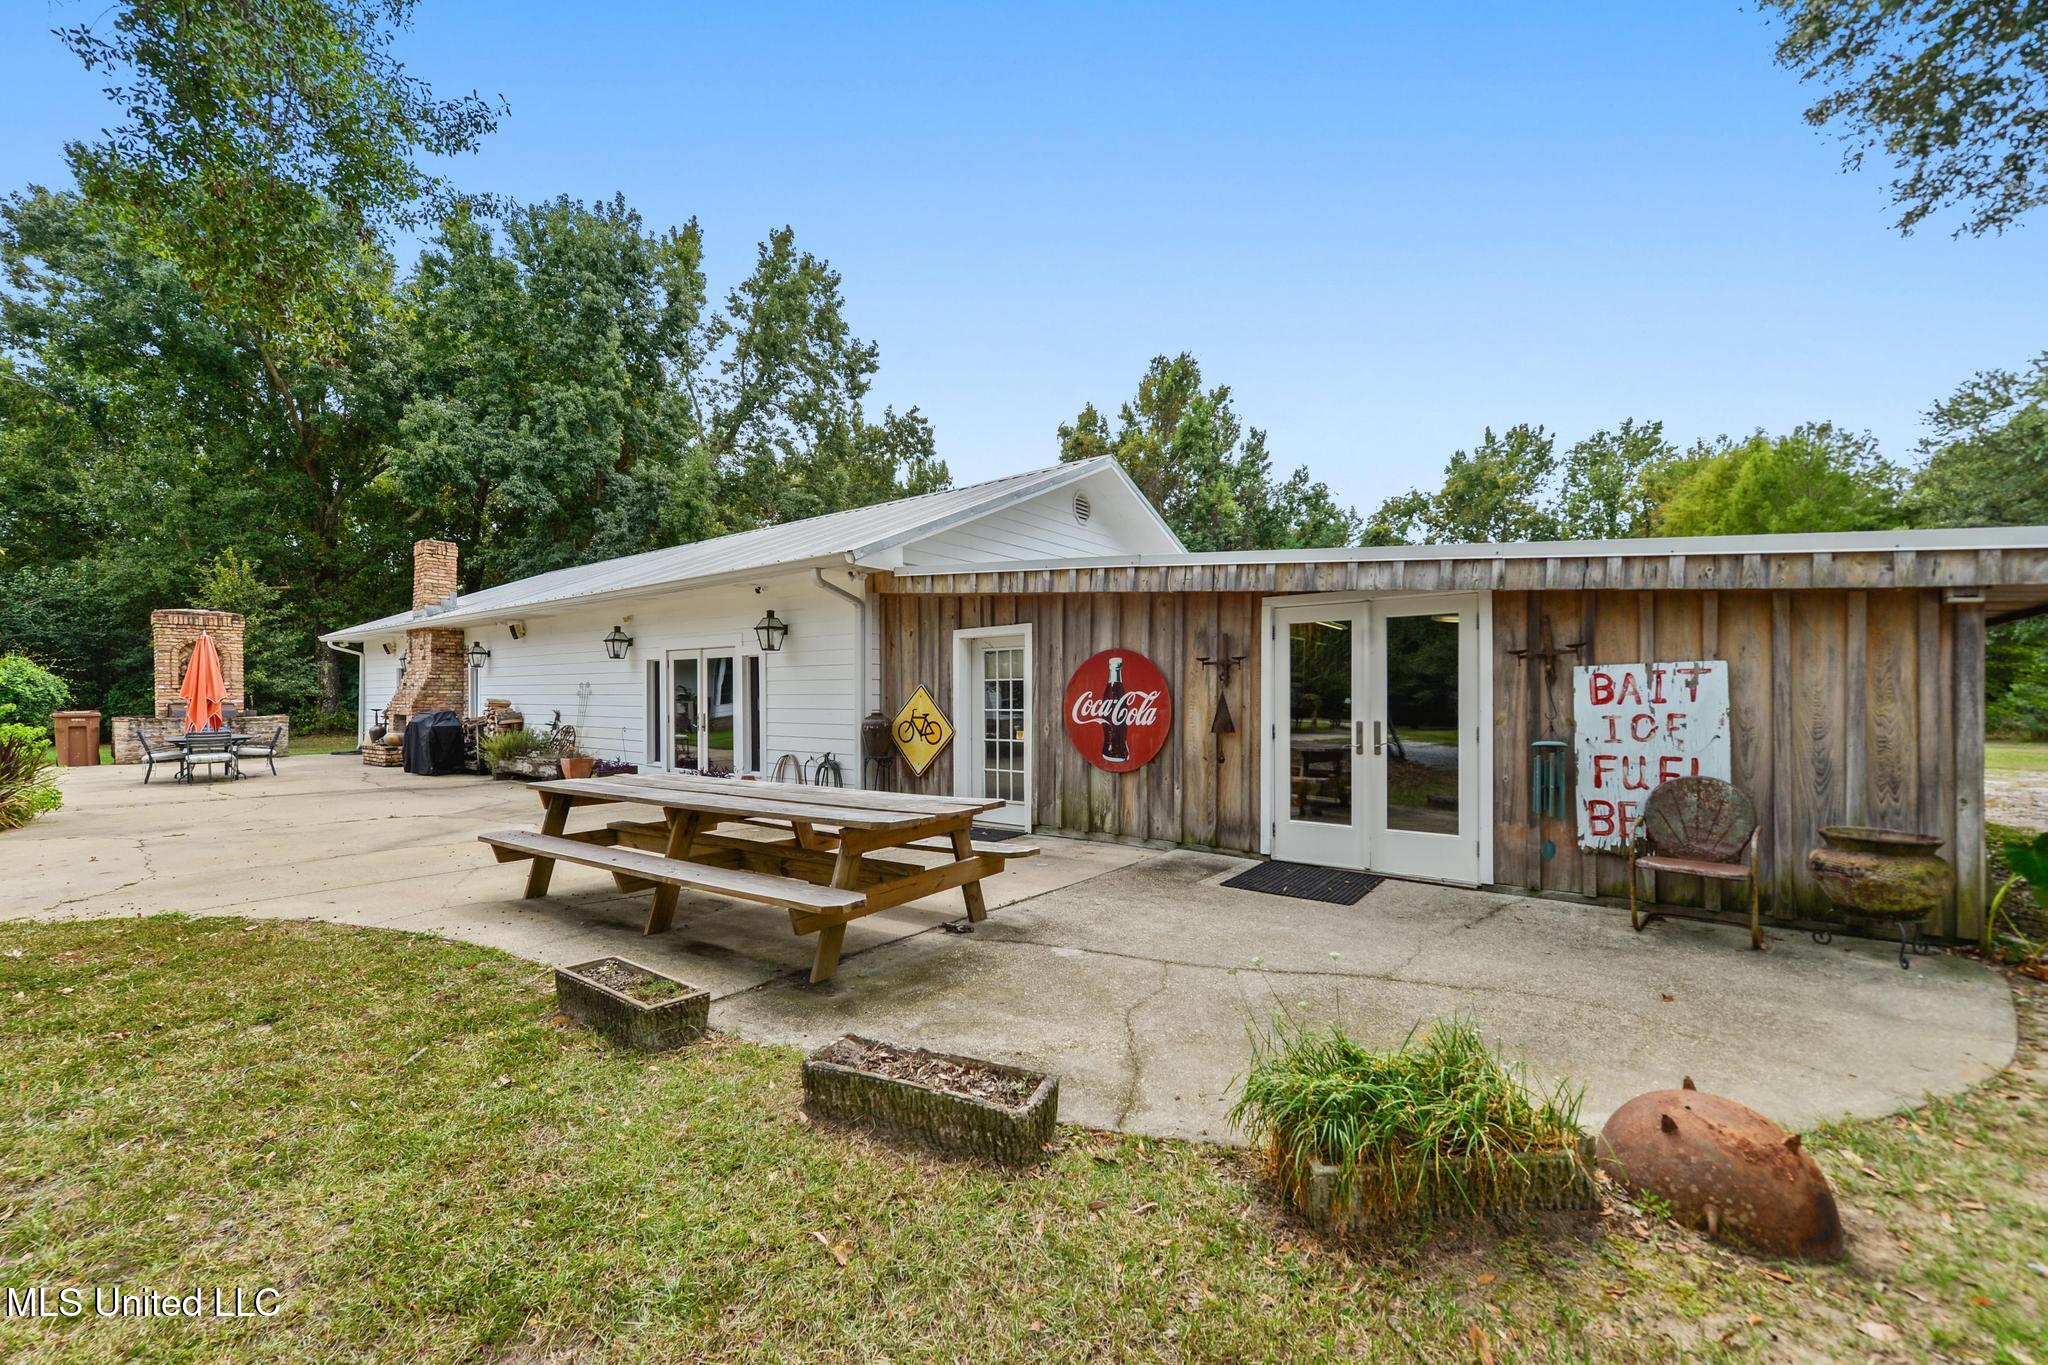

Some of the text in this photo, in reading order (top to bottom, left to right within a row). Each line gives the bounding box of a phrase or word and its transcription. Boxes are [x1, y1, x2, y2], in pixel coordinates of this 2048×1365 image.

[1588, 668, 1712, 705] BAIT
[1072, 690, 1161, 726] Coca-Cola
[1601, 713, 1687, 747] ICE
[1586, 799, 1649, 839] BE
